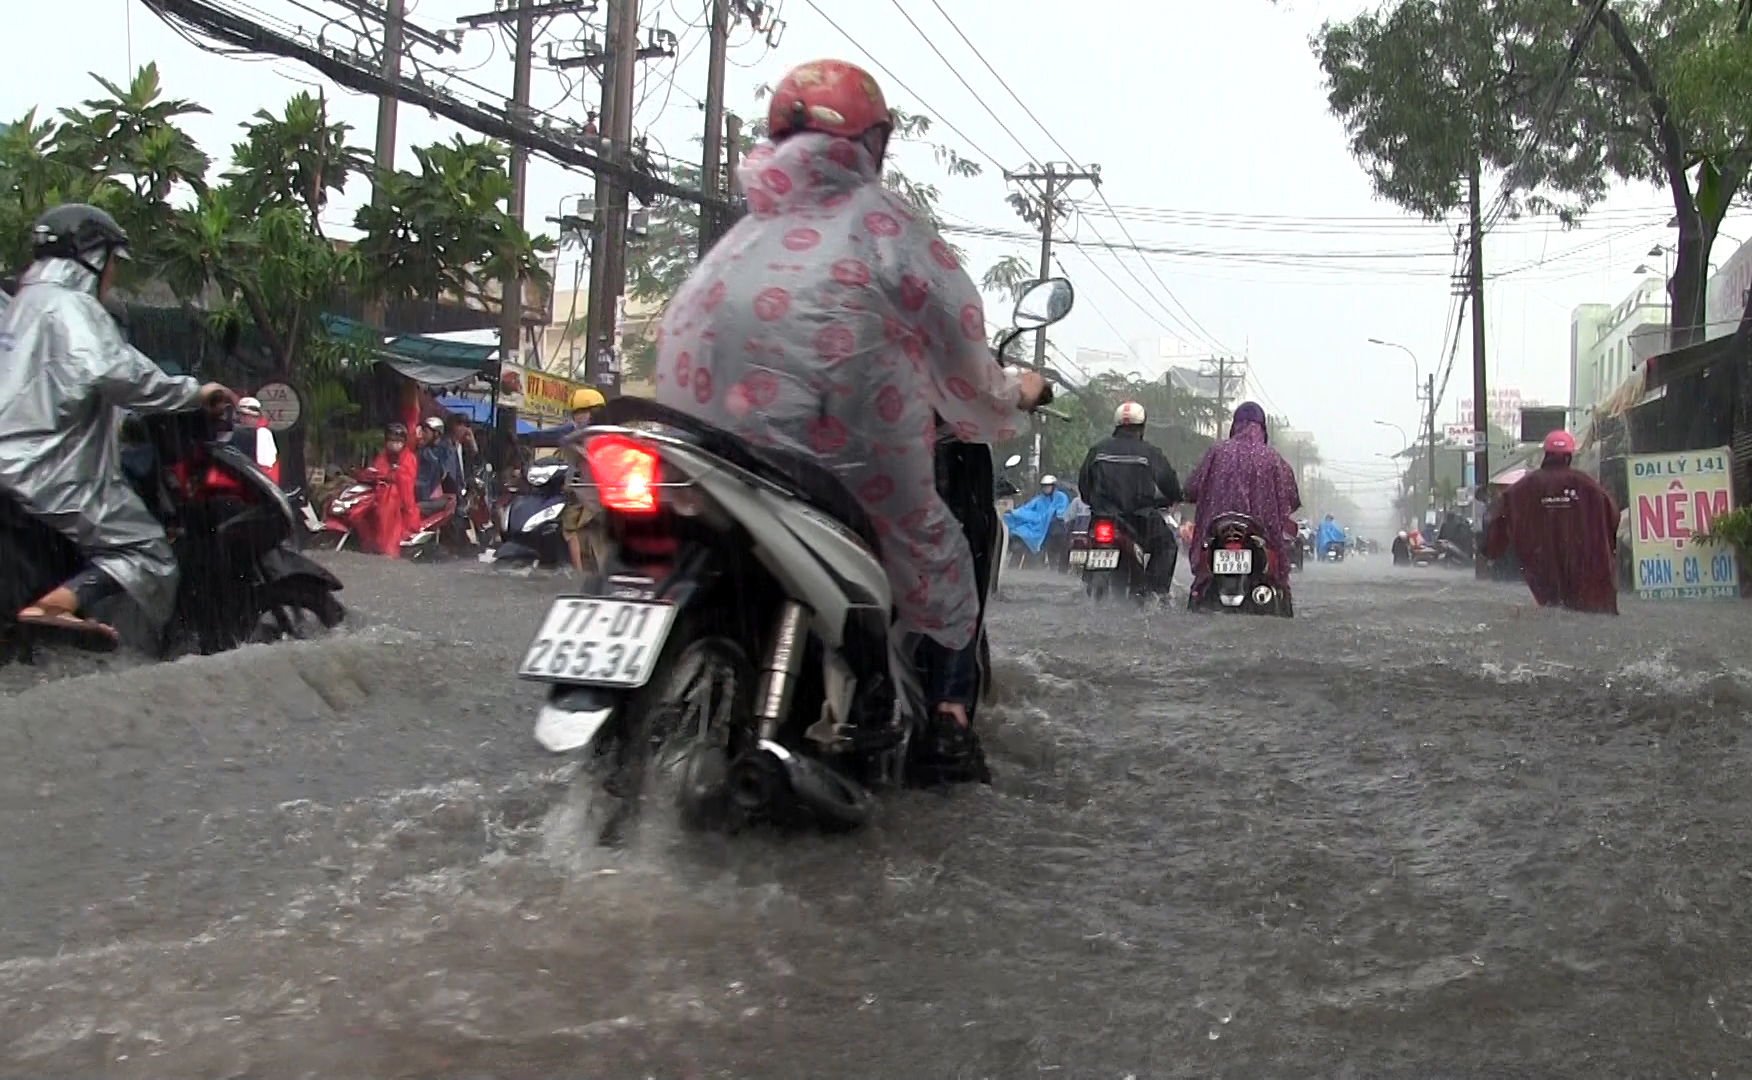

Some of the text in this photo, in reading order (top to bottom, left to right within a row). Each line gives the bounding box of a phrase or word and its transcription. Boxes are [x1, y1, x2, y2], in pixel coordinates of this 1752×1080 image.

[1696, 457, 1725, 472] 141
[1639, 479, 1729, 548] NỆM
[1683, 556, 1700, 583] GA
[527, 639, 647, 679] 265.34
